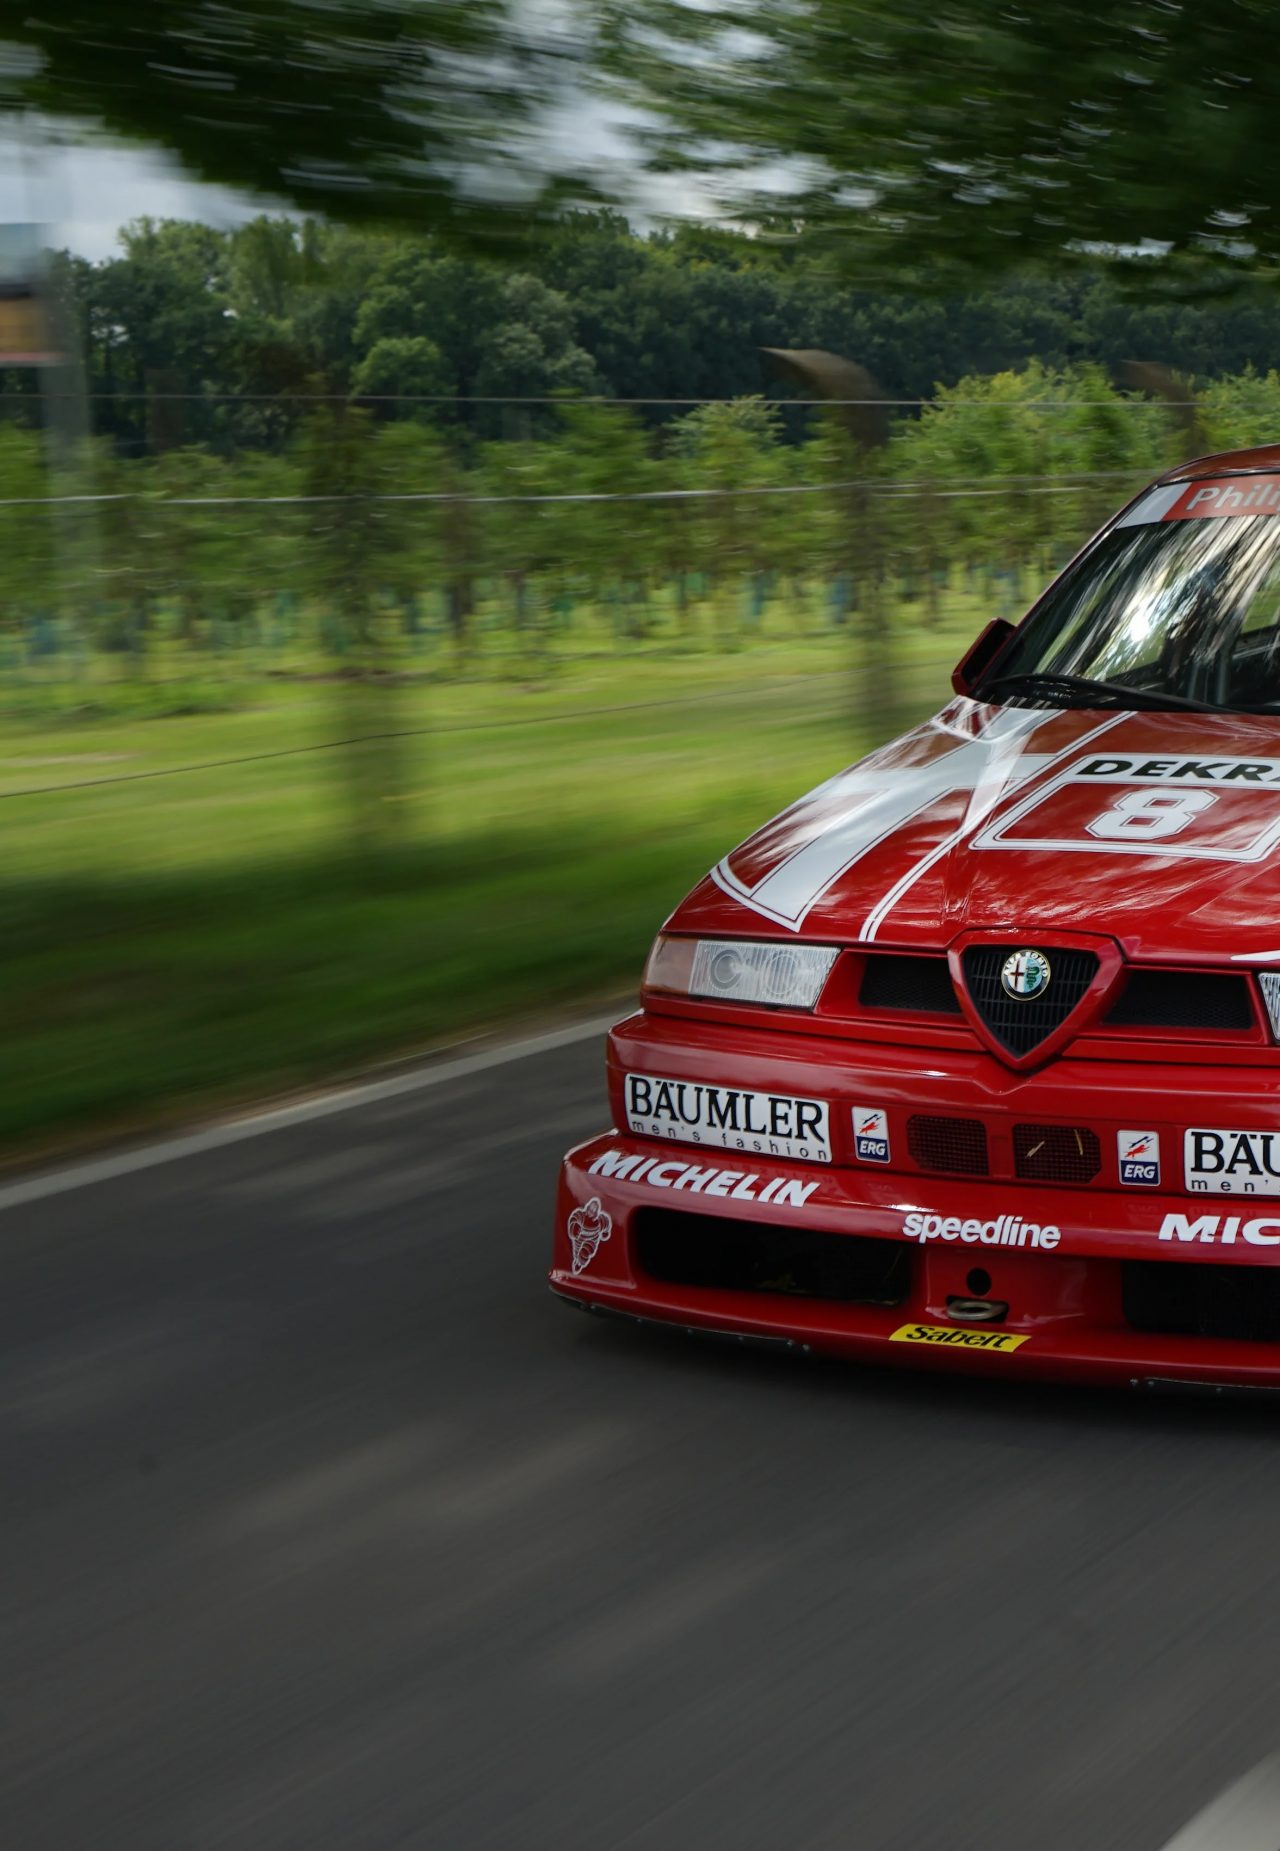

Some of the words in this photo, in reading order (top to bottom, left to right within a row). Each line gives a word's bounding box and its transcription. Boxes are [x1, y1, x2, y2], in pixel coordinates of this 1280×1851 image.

[1085, 788, 1221, 840] 8
[630, 1076, 825, 1143] BÄUMLER
[632, 1121, 701, 1142] men's
[721, 1133, 827, 1160] fashion
[859, 1140, 886, 1156] ERG
[588, 1150, 821, 1207] MICHELIN
[1124, 1164, 1156, 1179] ERG
[903, 1213, 1061, 1249] speedline
[906, 1325, 1014, 1348] Sabelt
